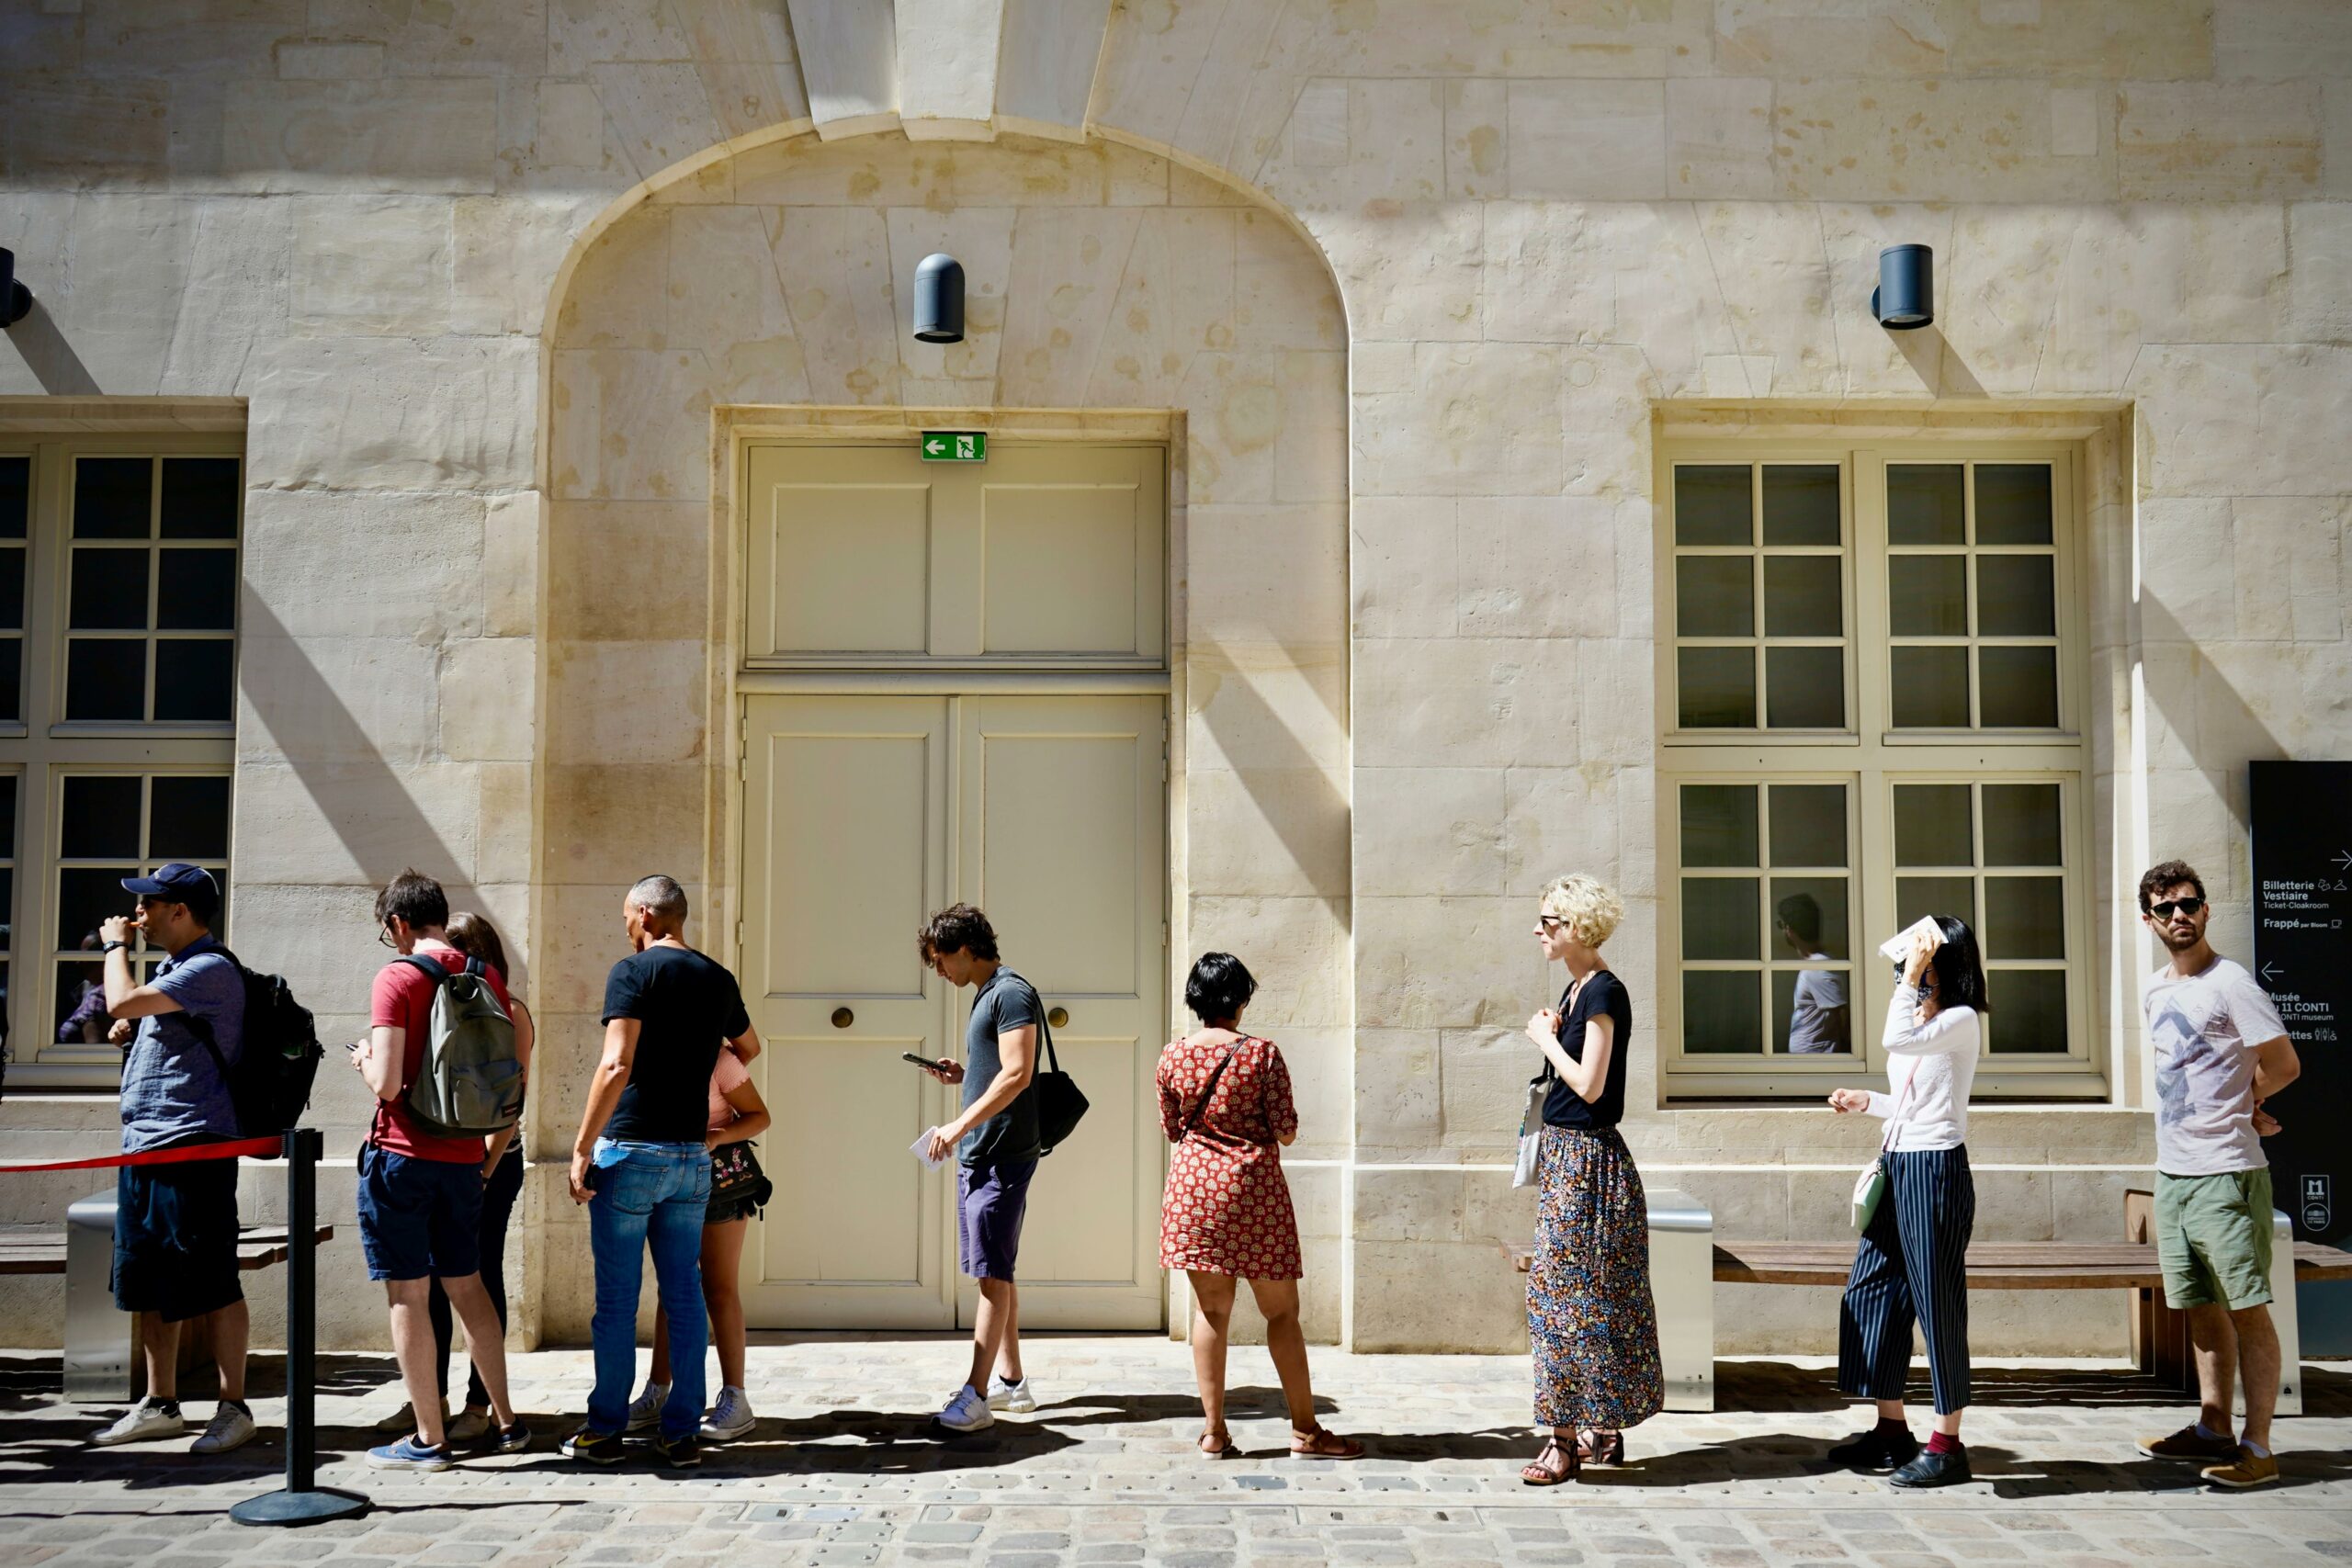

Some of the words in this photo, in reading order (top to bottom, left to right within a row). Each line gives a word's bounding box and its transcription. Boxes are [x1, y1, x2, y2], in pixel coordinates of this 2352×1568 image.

[2263, 881, 2314, 890] Billetterie
[2263, 891, 2309, 900] Vestiaire
[2264, 901, 2329, 909] Ticket-Cloakroom
[2264, 919, 2299, 930] Frappé
[2268, 993, 2300, 1001] Musée
[2282, 1003, 2292, 1012] 11
[2295, 1003, 2329, 1011] CONTI
[2287, 1031, 2312, 1039] ettes
